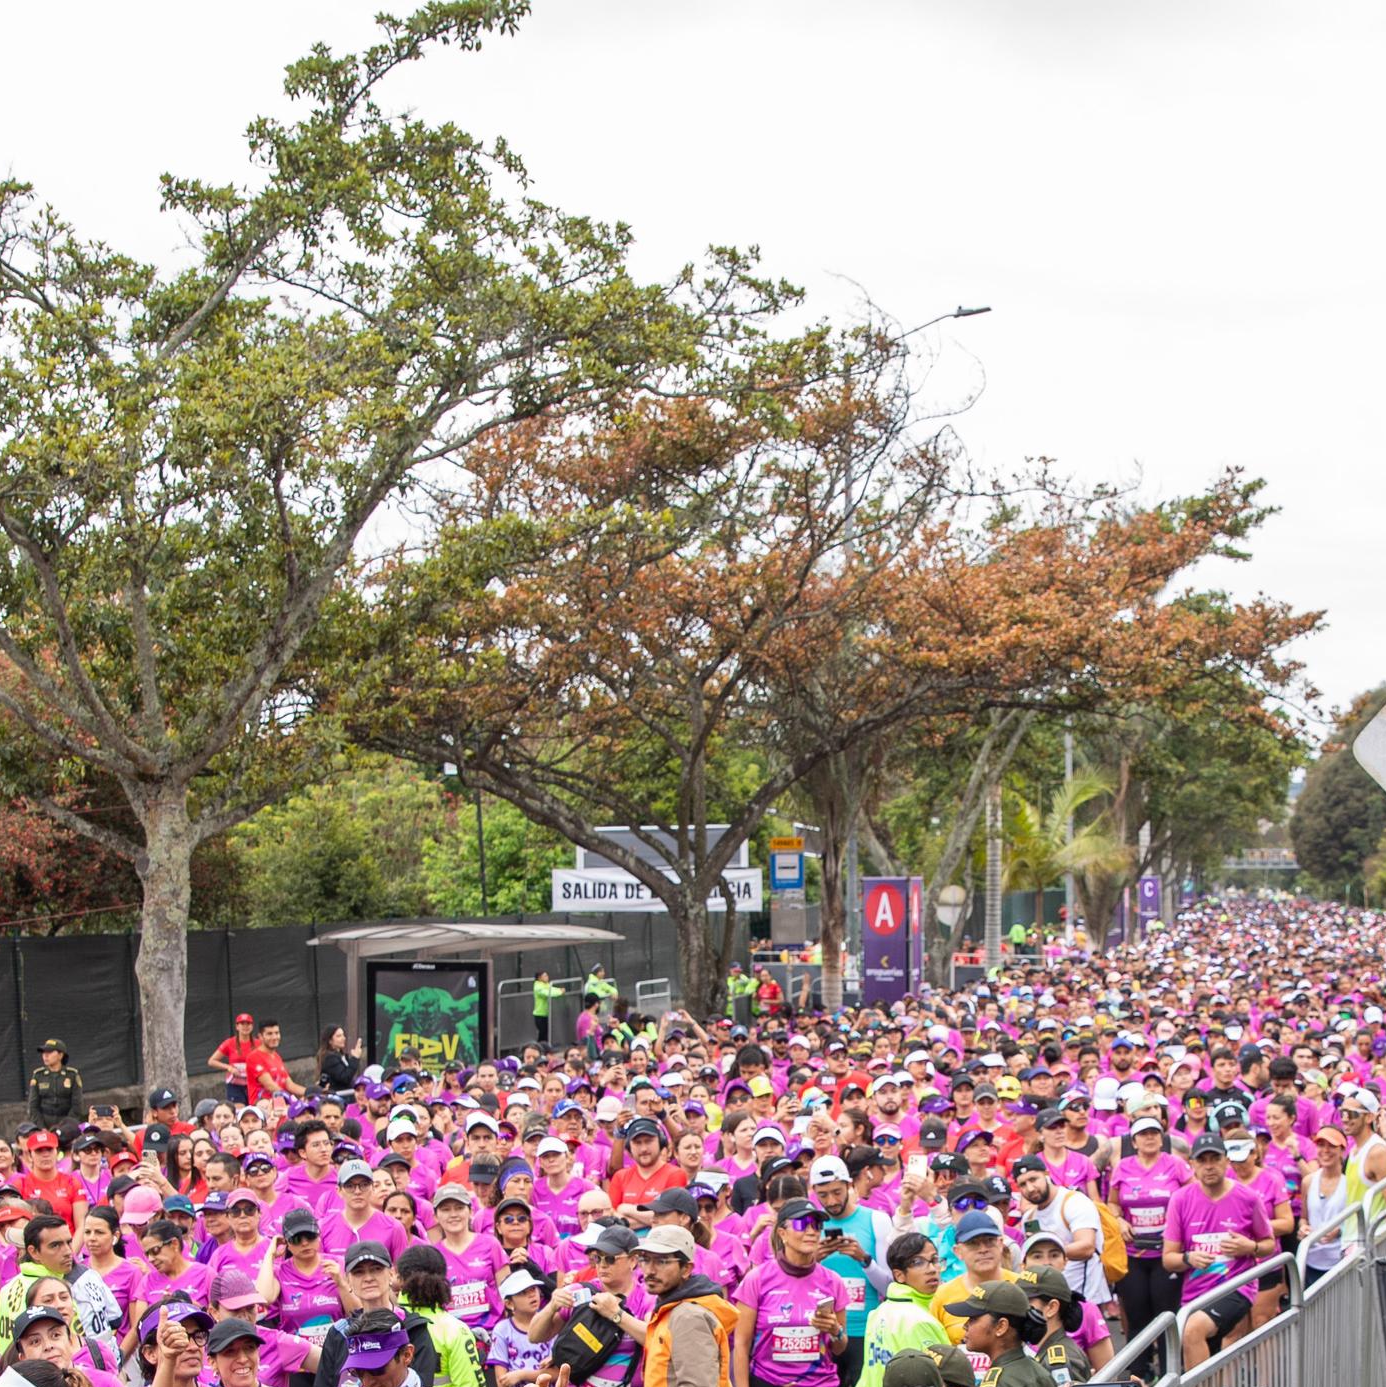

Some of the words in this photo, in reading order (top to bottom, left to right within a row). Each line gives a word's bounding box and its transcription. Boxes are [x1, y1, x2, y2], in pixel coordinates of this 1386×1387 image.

[562, 881, 617, 899] SALIDA
[625, 881, 648, 899] DE
[1143, 881, 1154, 898] C
[876, 891, 894, 928] A
[782, 1338, 812, 1350] 25265
